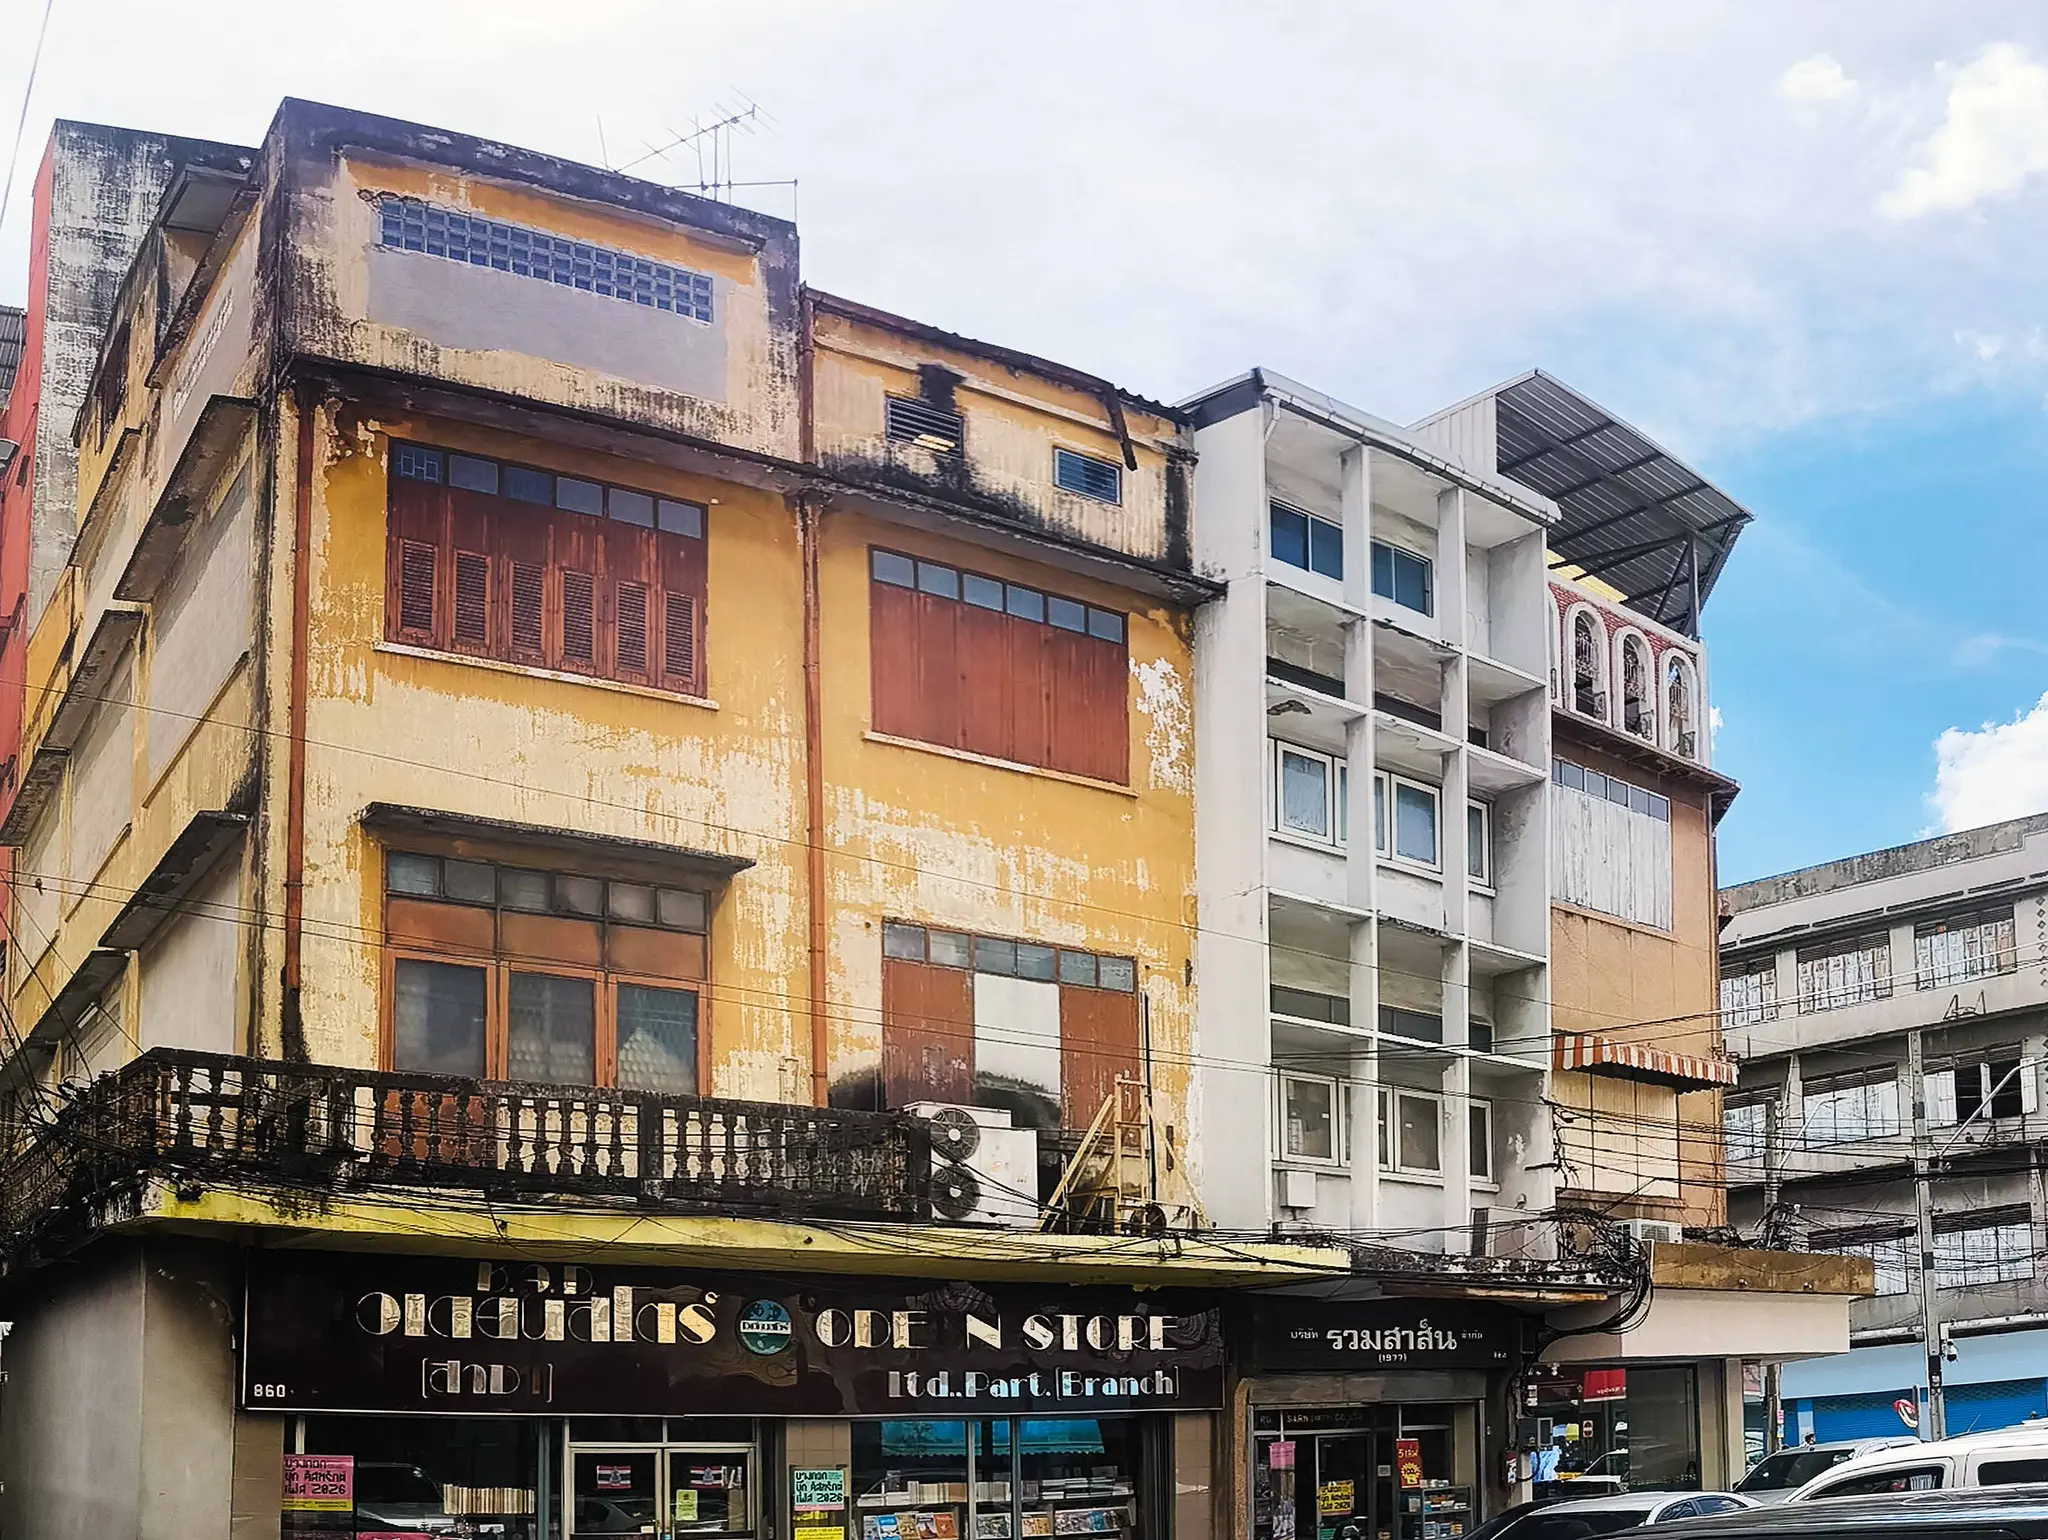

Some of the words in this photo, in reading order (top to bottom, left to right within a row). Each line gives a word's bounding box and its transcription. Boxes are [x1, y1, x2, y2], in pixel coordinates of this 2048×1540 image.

[1022, 1313, 1178, 1351] STORE
[1378, 1353, 1408, 1363] (1977)
[253, 1383, 286, 1398] 860
[311, 1483, 347, 1495] 2026
[816, 1492, 843, 1503] 2026
